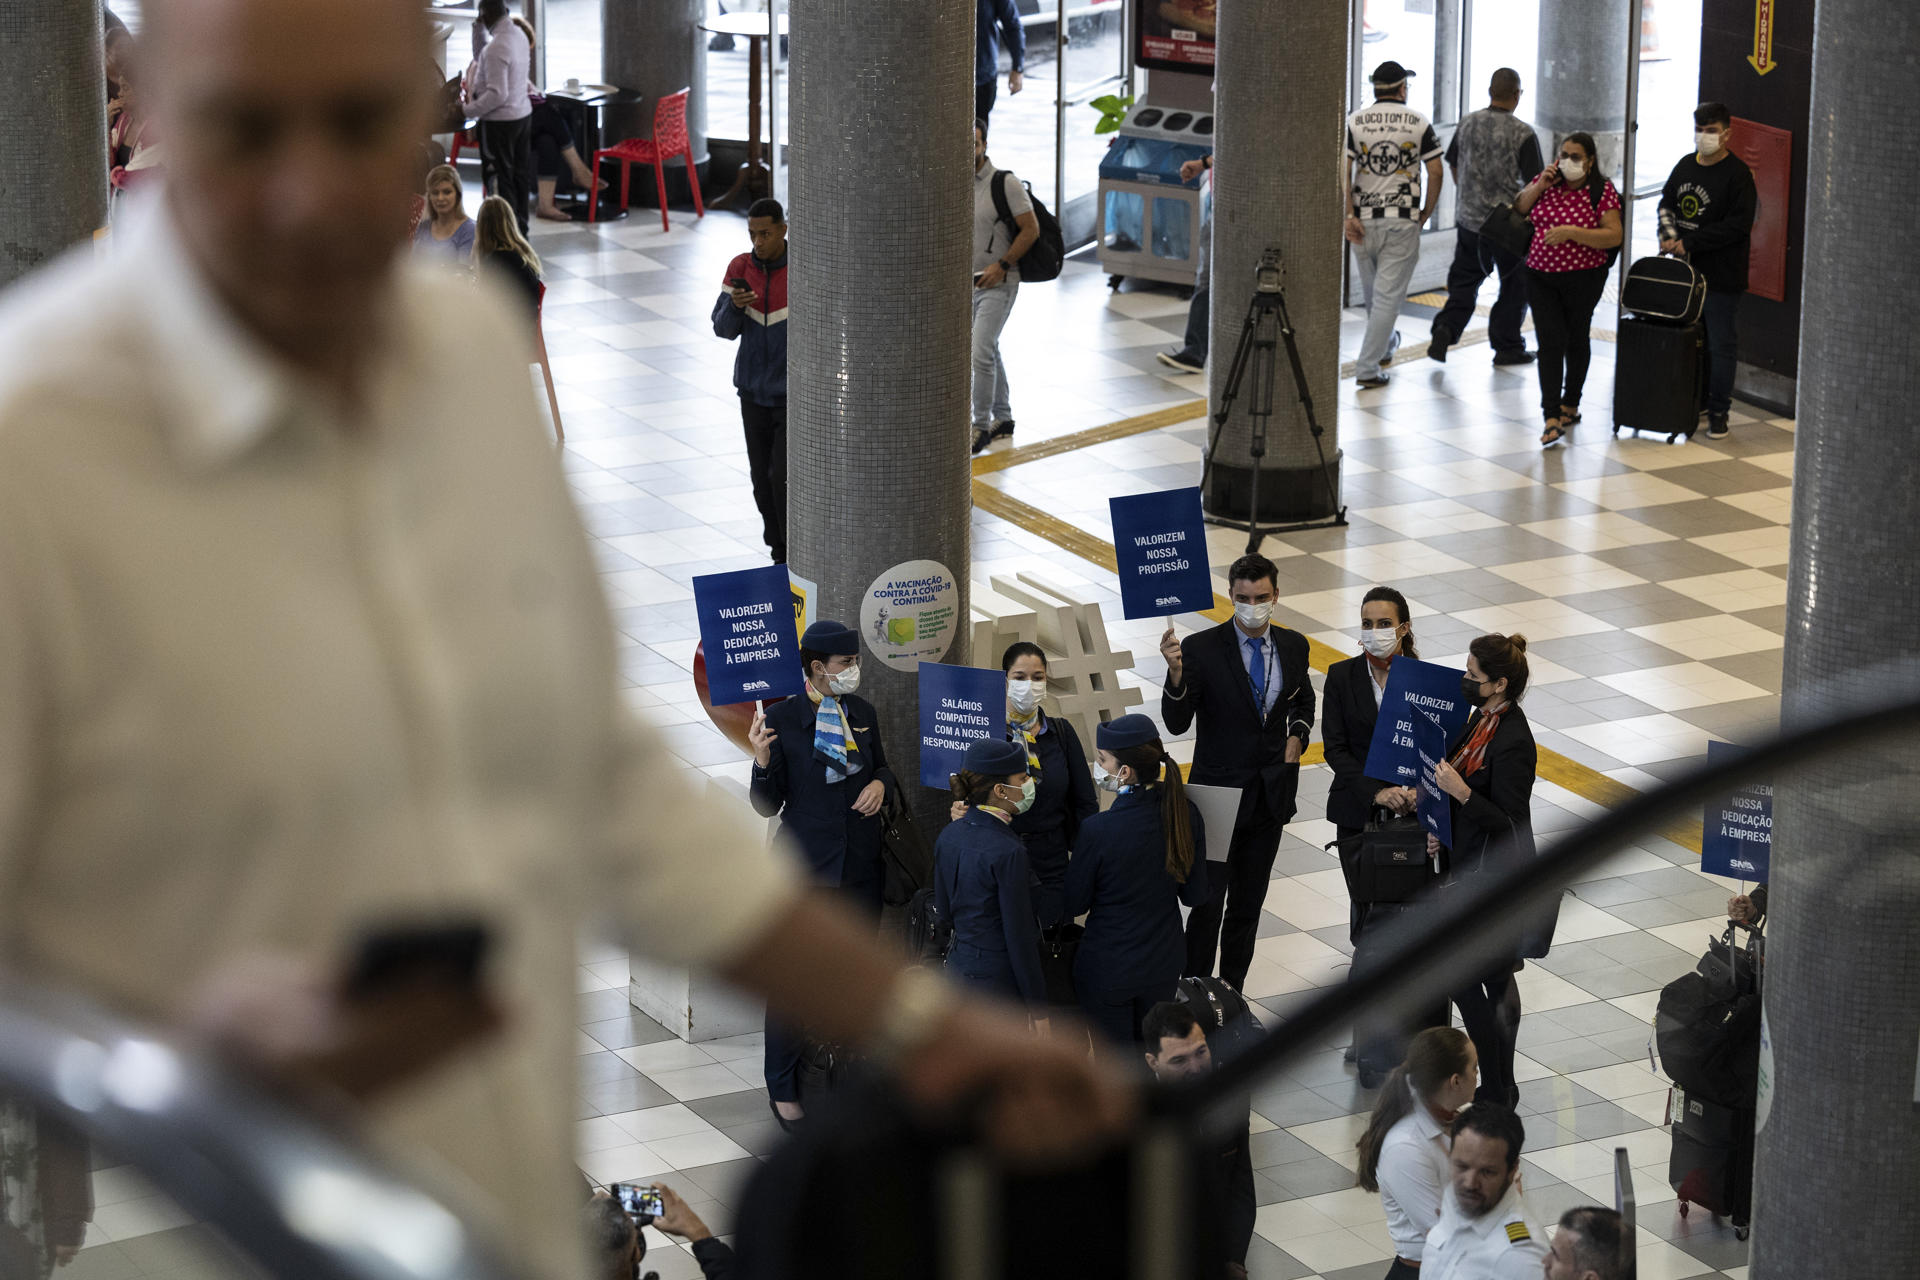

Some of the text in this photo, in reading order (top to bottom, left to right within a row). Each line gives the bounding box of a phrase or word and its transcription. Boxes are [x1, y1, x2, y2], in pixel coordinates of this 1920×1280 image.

[1758, 4, 1768, 66] HIDRANTE
[1134, 531, 1186, 547] VALORIZEM
[1146, 547, 1178, 560] NOSSA
[1138, 558, 1190, 575] PROFISSÃO
[886, 576, 942, 590] A VACINAÇÃO
[874, 588, 910, 598] CONTRA
[912, 588, 918, 596] A
[892, 594, 938, 606] CONTINUA.
[719, 602, 774, 619] VALORIZEM
[732, 619, 766, 633] NOSSA
[724, 632, 778, 650] DEDICAÇÃO
[726, 648, 781, 664] À EMPRESA
[942, 698, 983, 712] SALÁRIOS
[1404, 691, 1455, 712] VALORIZEM
[936, 711, 990, 726] COMPATÍVEIS
[934, 724, 990, 739] COM A NOSSA
[1392, 732, 1399, 745] À
[1732, 796, 1763, 811] NOSSA
[1722, 810, 1773, 828] DEDICAÇÃO
[1721, 823, 1772, 844] À EMPRESA
